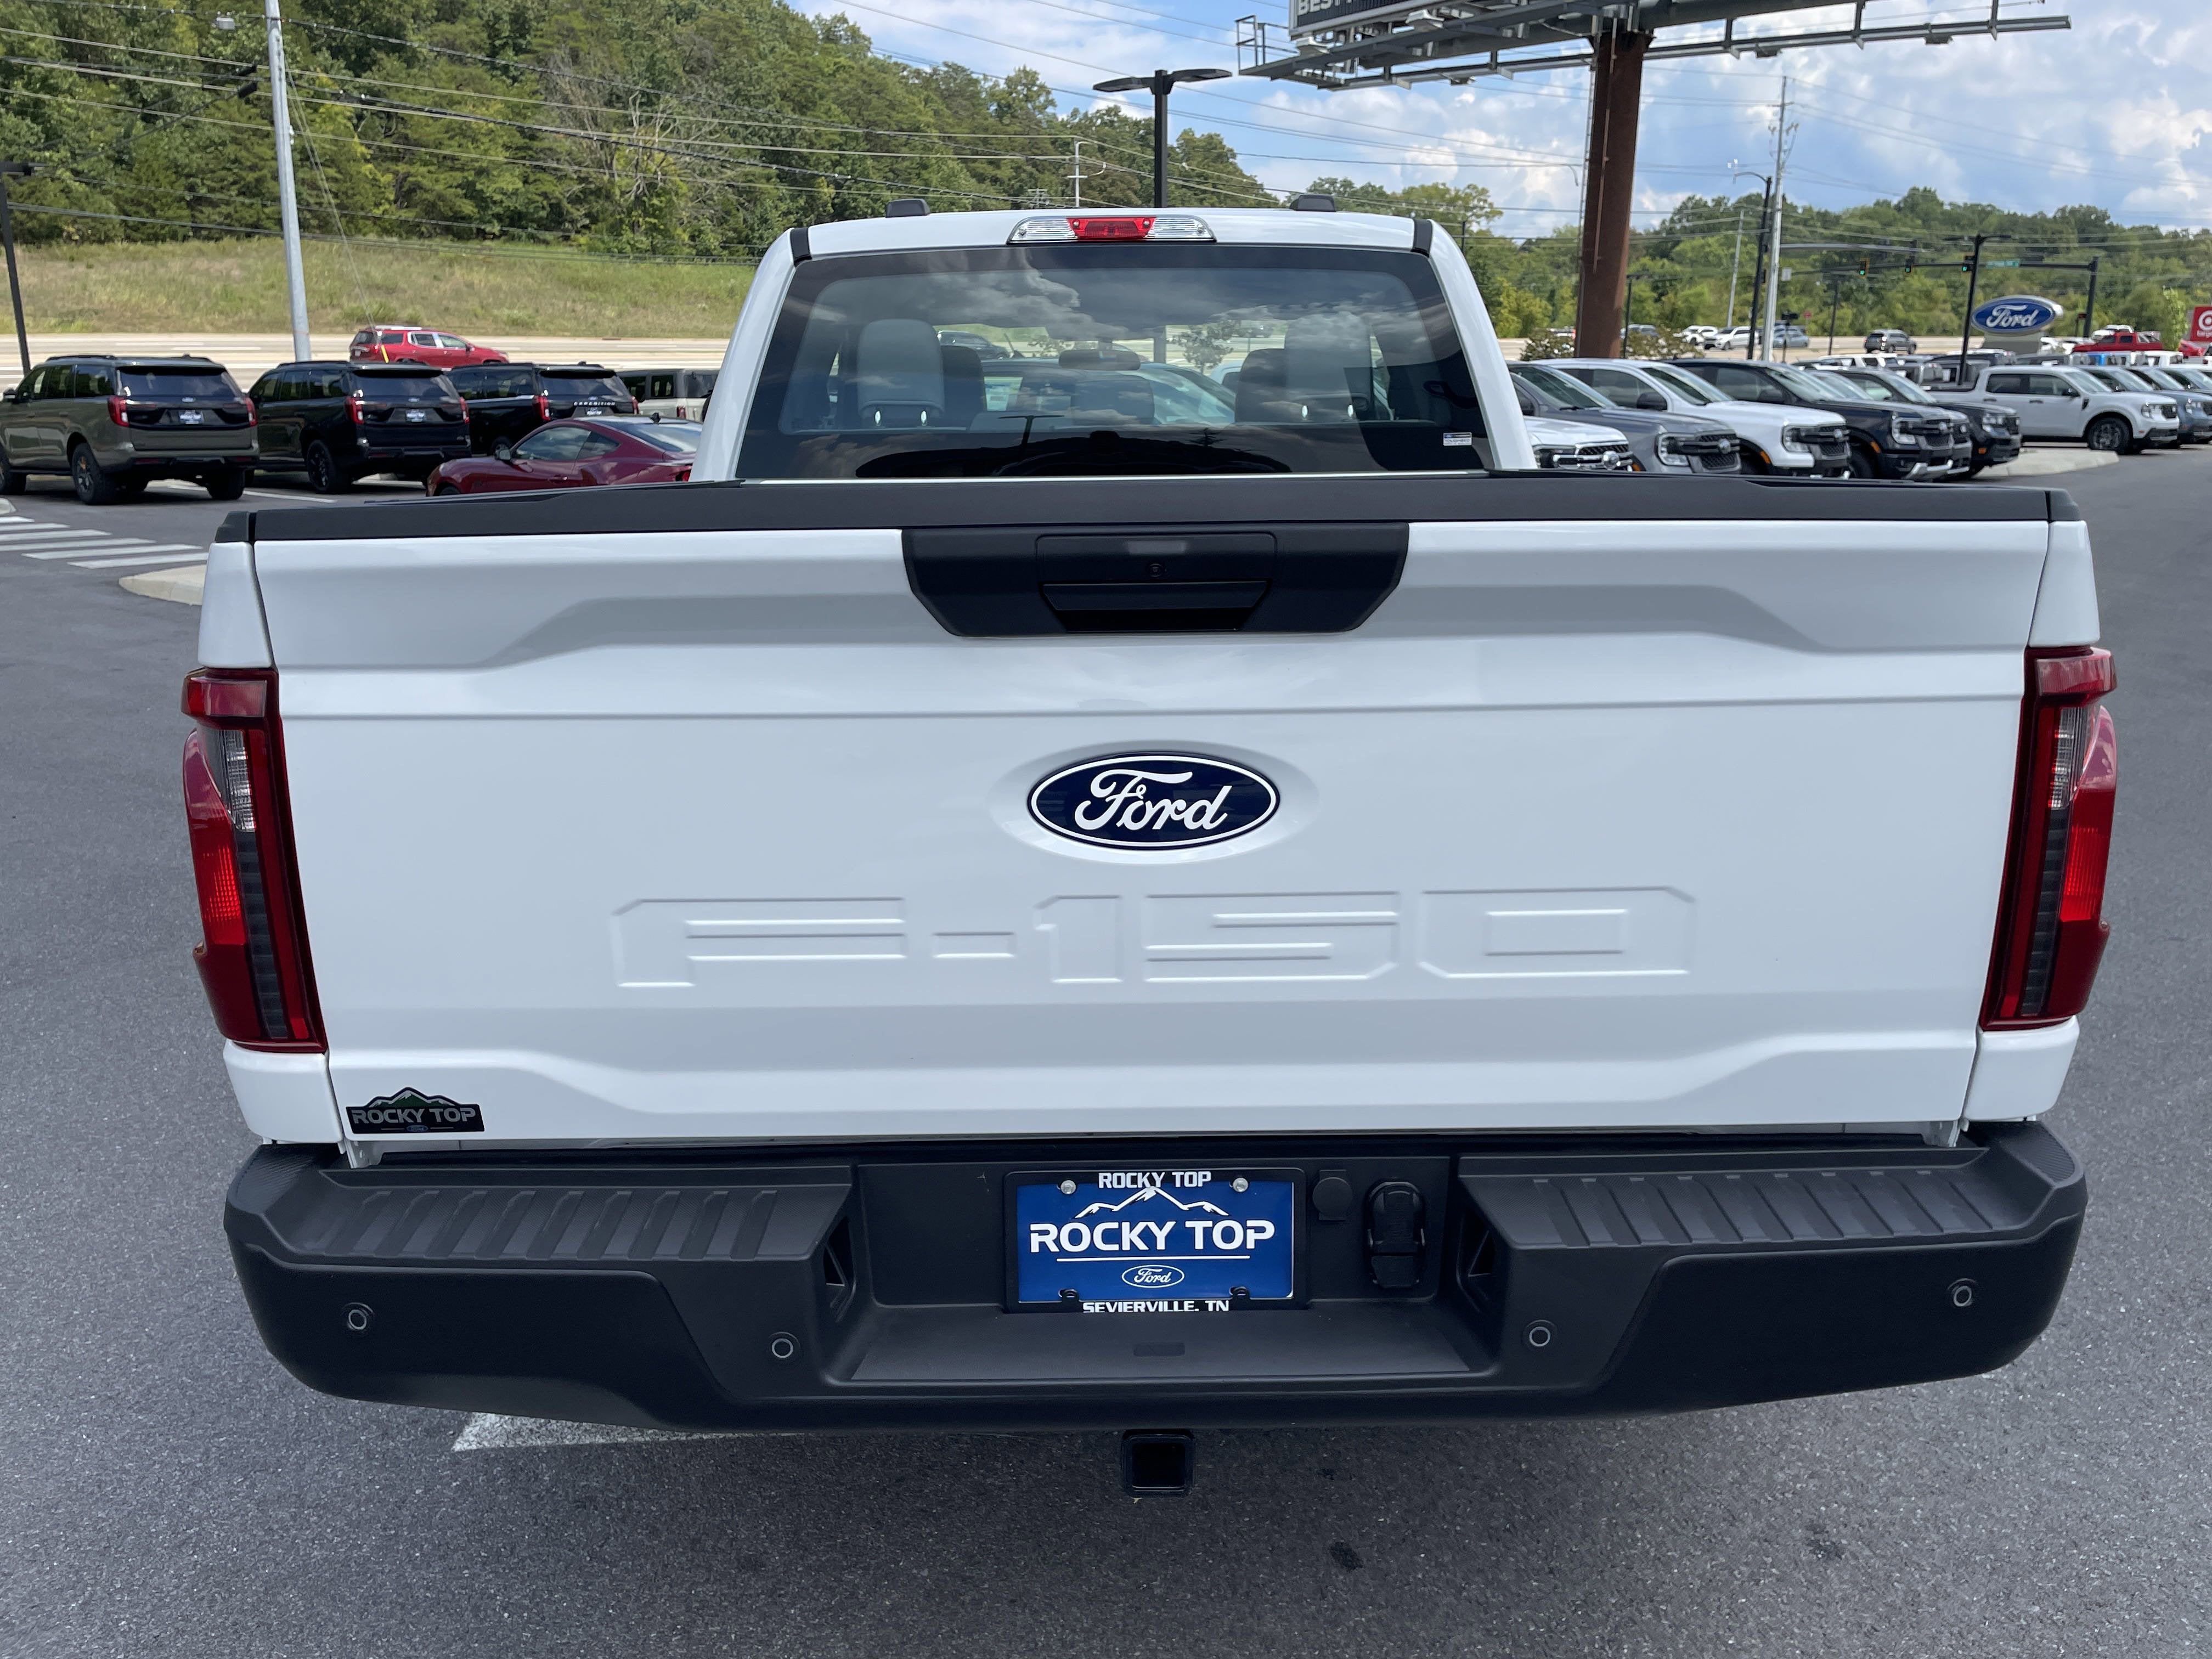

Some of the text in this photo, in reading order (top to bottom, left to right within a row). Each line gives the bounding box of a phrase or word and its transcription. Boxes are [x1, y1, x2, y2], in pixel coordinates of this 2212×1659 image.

[1985, 304, 2040, 328] Ford
[1074, 768, 1234, 831] Ford
[611, 885, 1697, 989] F-150
[351, 1107, 476, 1124] ROCKY TOP
[1098, 1171, 1212, 1189] ROCKY TOP
[1030, 1219, 1276, 1253] ROCKY TOP
[1133, 1267, 1172, 1284] Ford
[1204, 1300, 1229, 1312] TN
